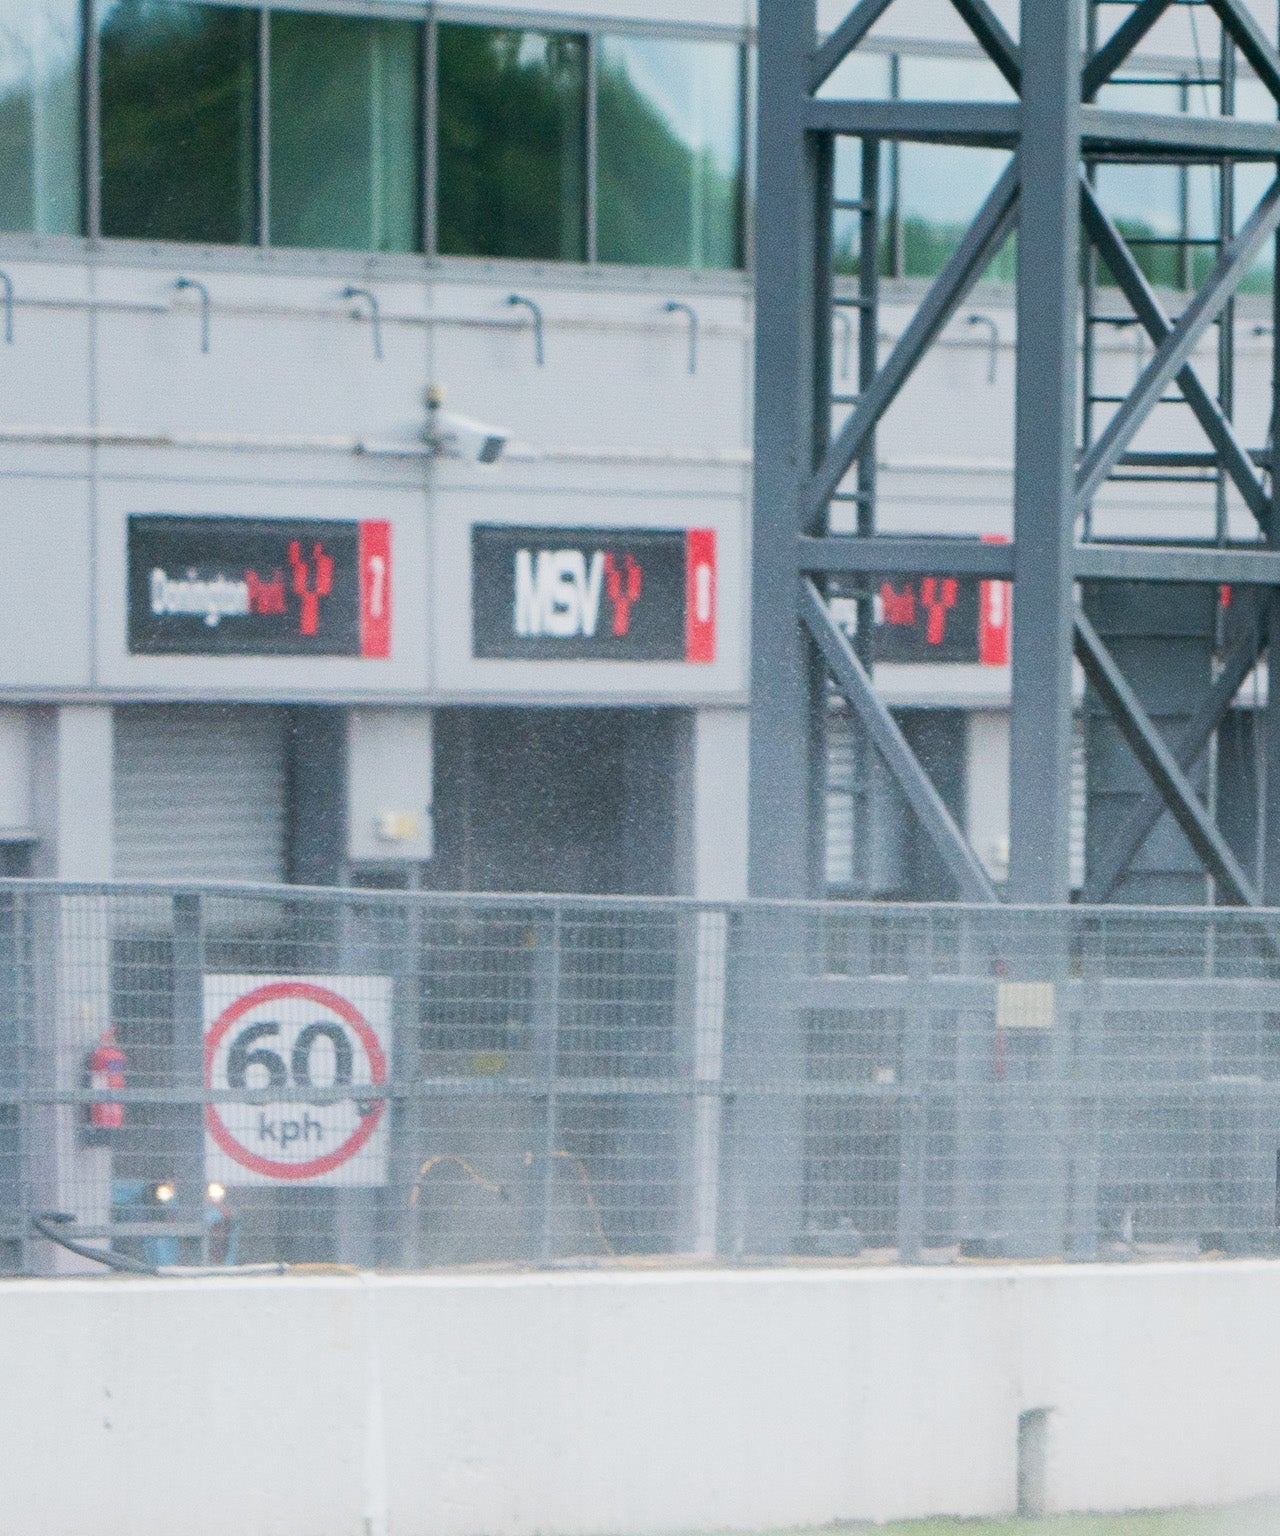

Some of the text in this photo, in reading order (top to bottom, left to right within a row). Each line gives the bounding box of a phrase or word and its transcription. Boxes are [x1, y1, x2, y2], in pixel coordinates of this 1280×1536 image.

[513, 549, 606, 638] MSV
[226, 1020, 354, 1107] 60
[258, 1112, 323, 1149] kph
